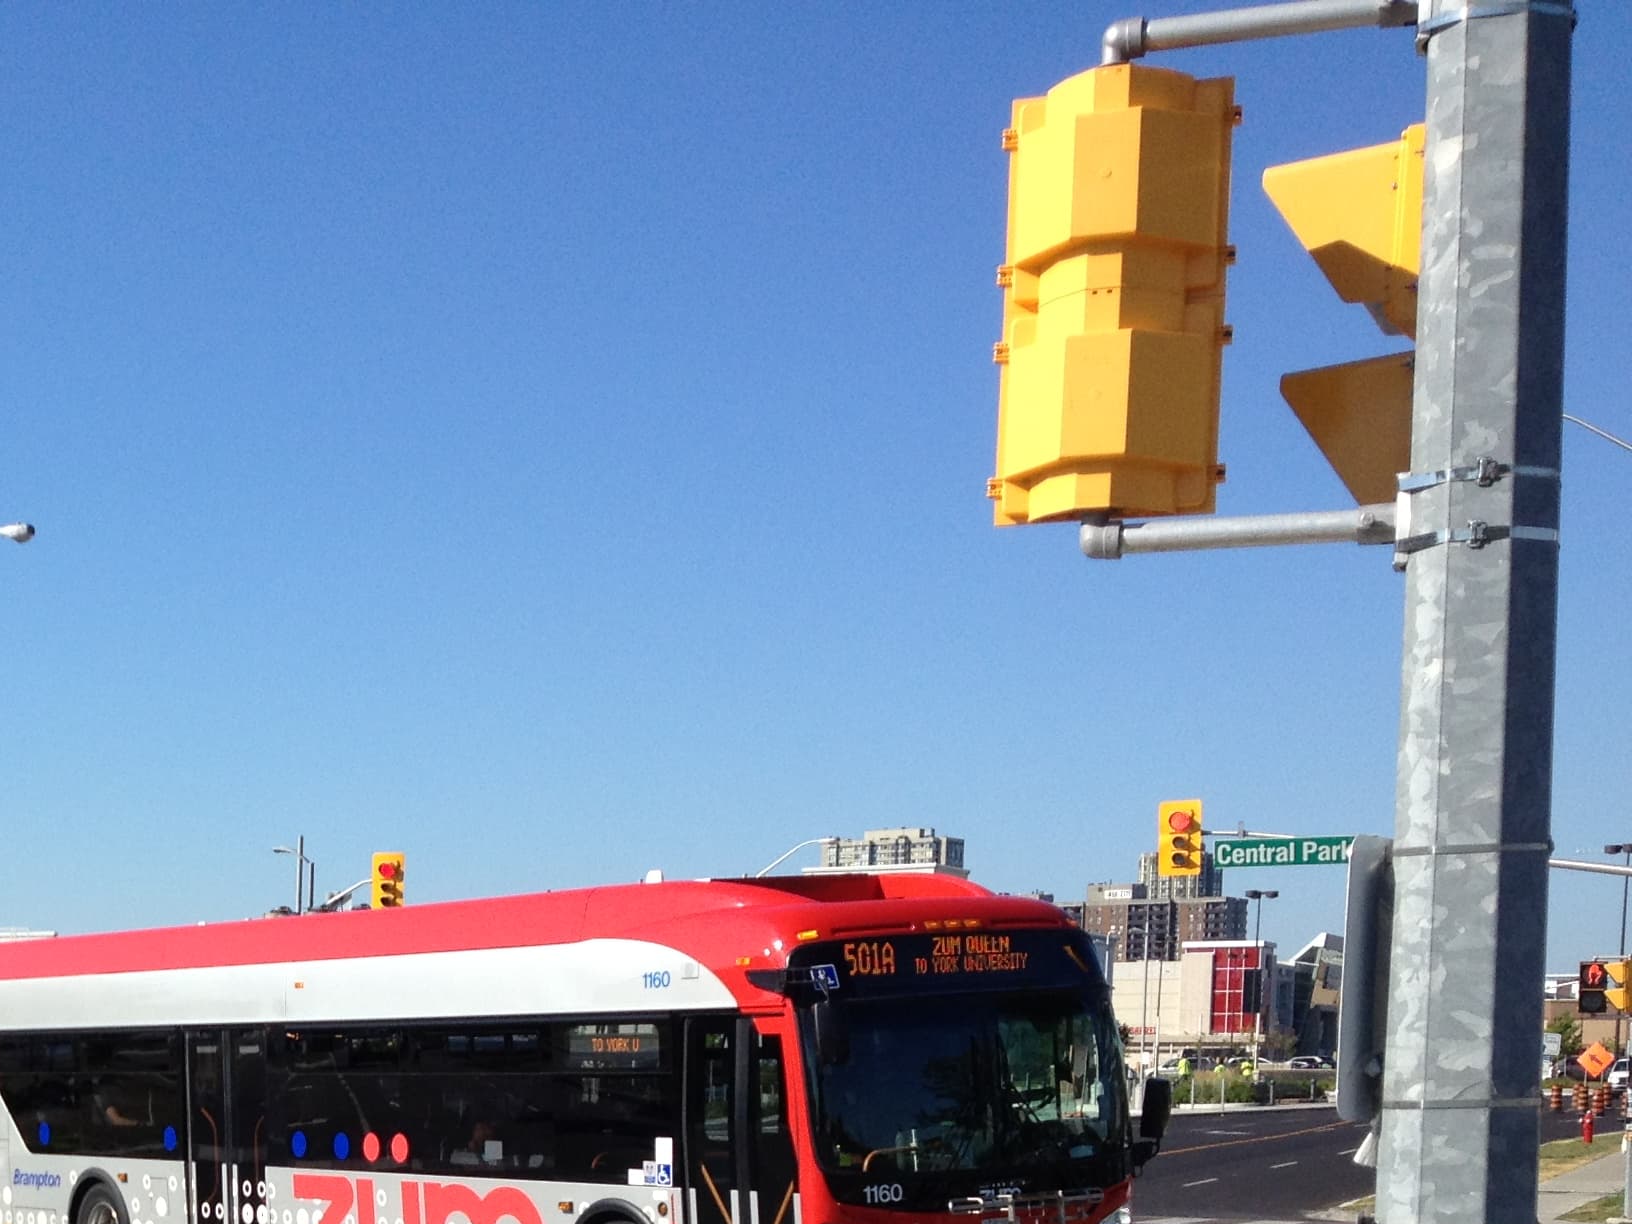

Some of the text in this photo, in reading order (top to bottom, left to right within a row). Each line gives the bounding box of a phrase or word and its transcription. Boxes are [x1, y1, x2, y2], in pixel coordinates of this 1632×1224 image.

[1218, 839, 1351, 865] Central Park
[932, 936, 1010, 956] ZUM QUEEN
[843, 942, 896, 976] 501A
[915, 953, 1028, 974] TO YORK UNIVERSITY
[642, 970, 671, 989] 1160
[591, 1037, 604, 1053] TO
[632, 1037, 641, 1053] U
[13, 1168, 62, 1191] Brampton
[863, 1183, 903, 1204] 1160
